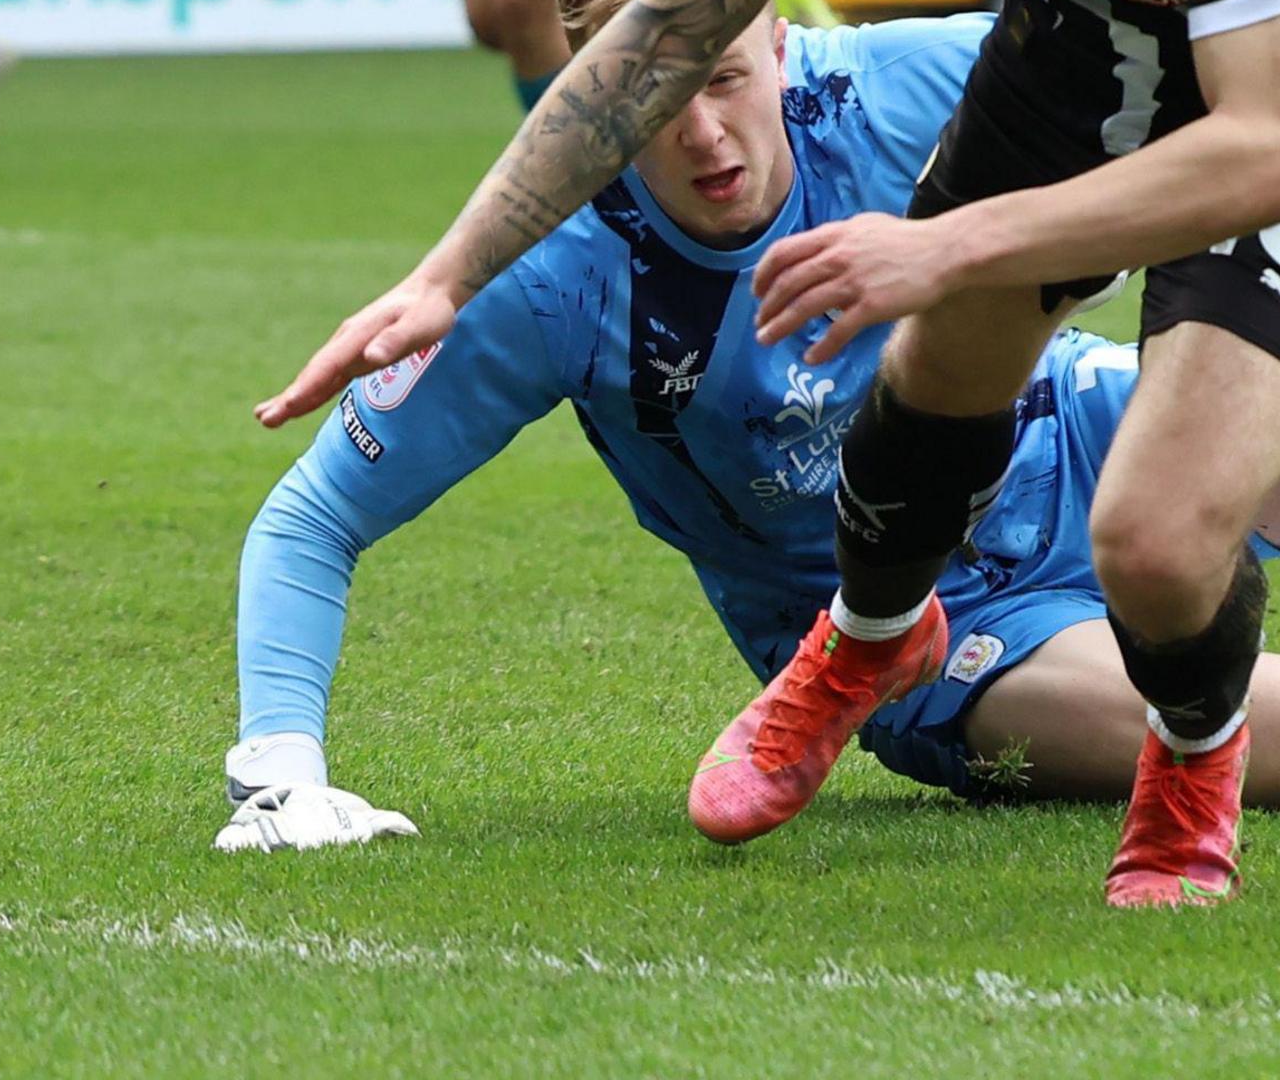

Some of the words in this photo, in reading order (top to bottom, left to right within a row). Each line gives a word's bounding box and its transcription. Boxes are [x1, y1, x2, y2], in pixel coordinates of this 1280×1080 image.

[368, 377, 384, 399] EFL
[658, 372, 705, 395] FBT
[749, 468, 790, 497] St
